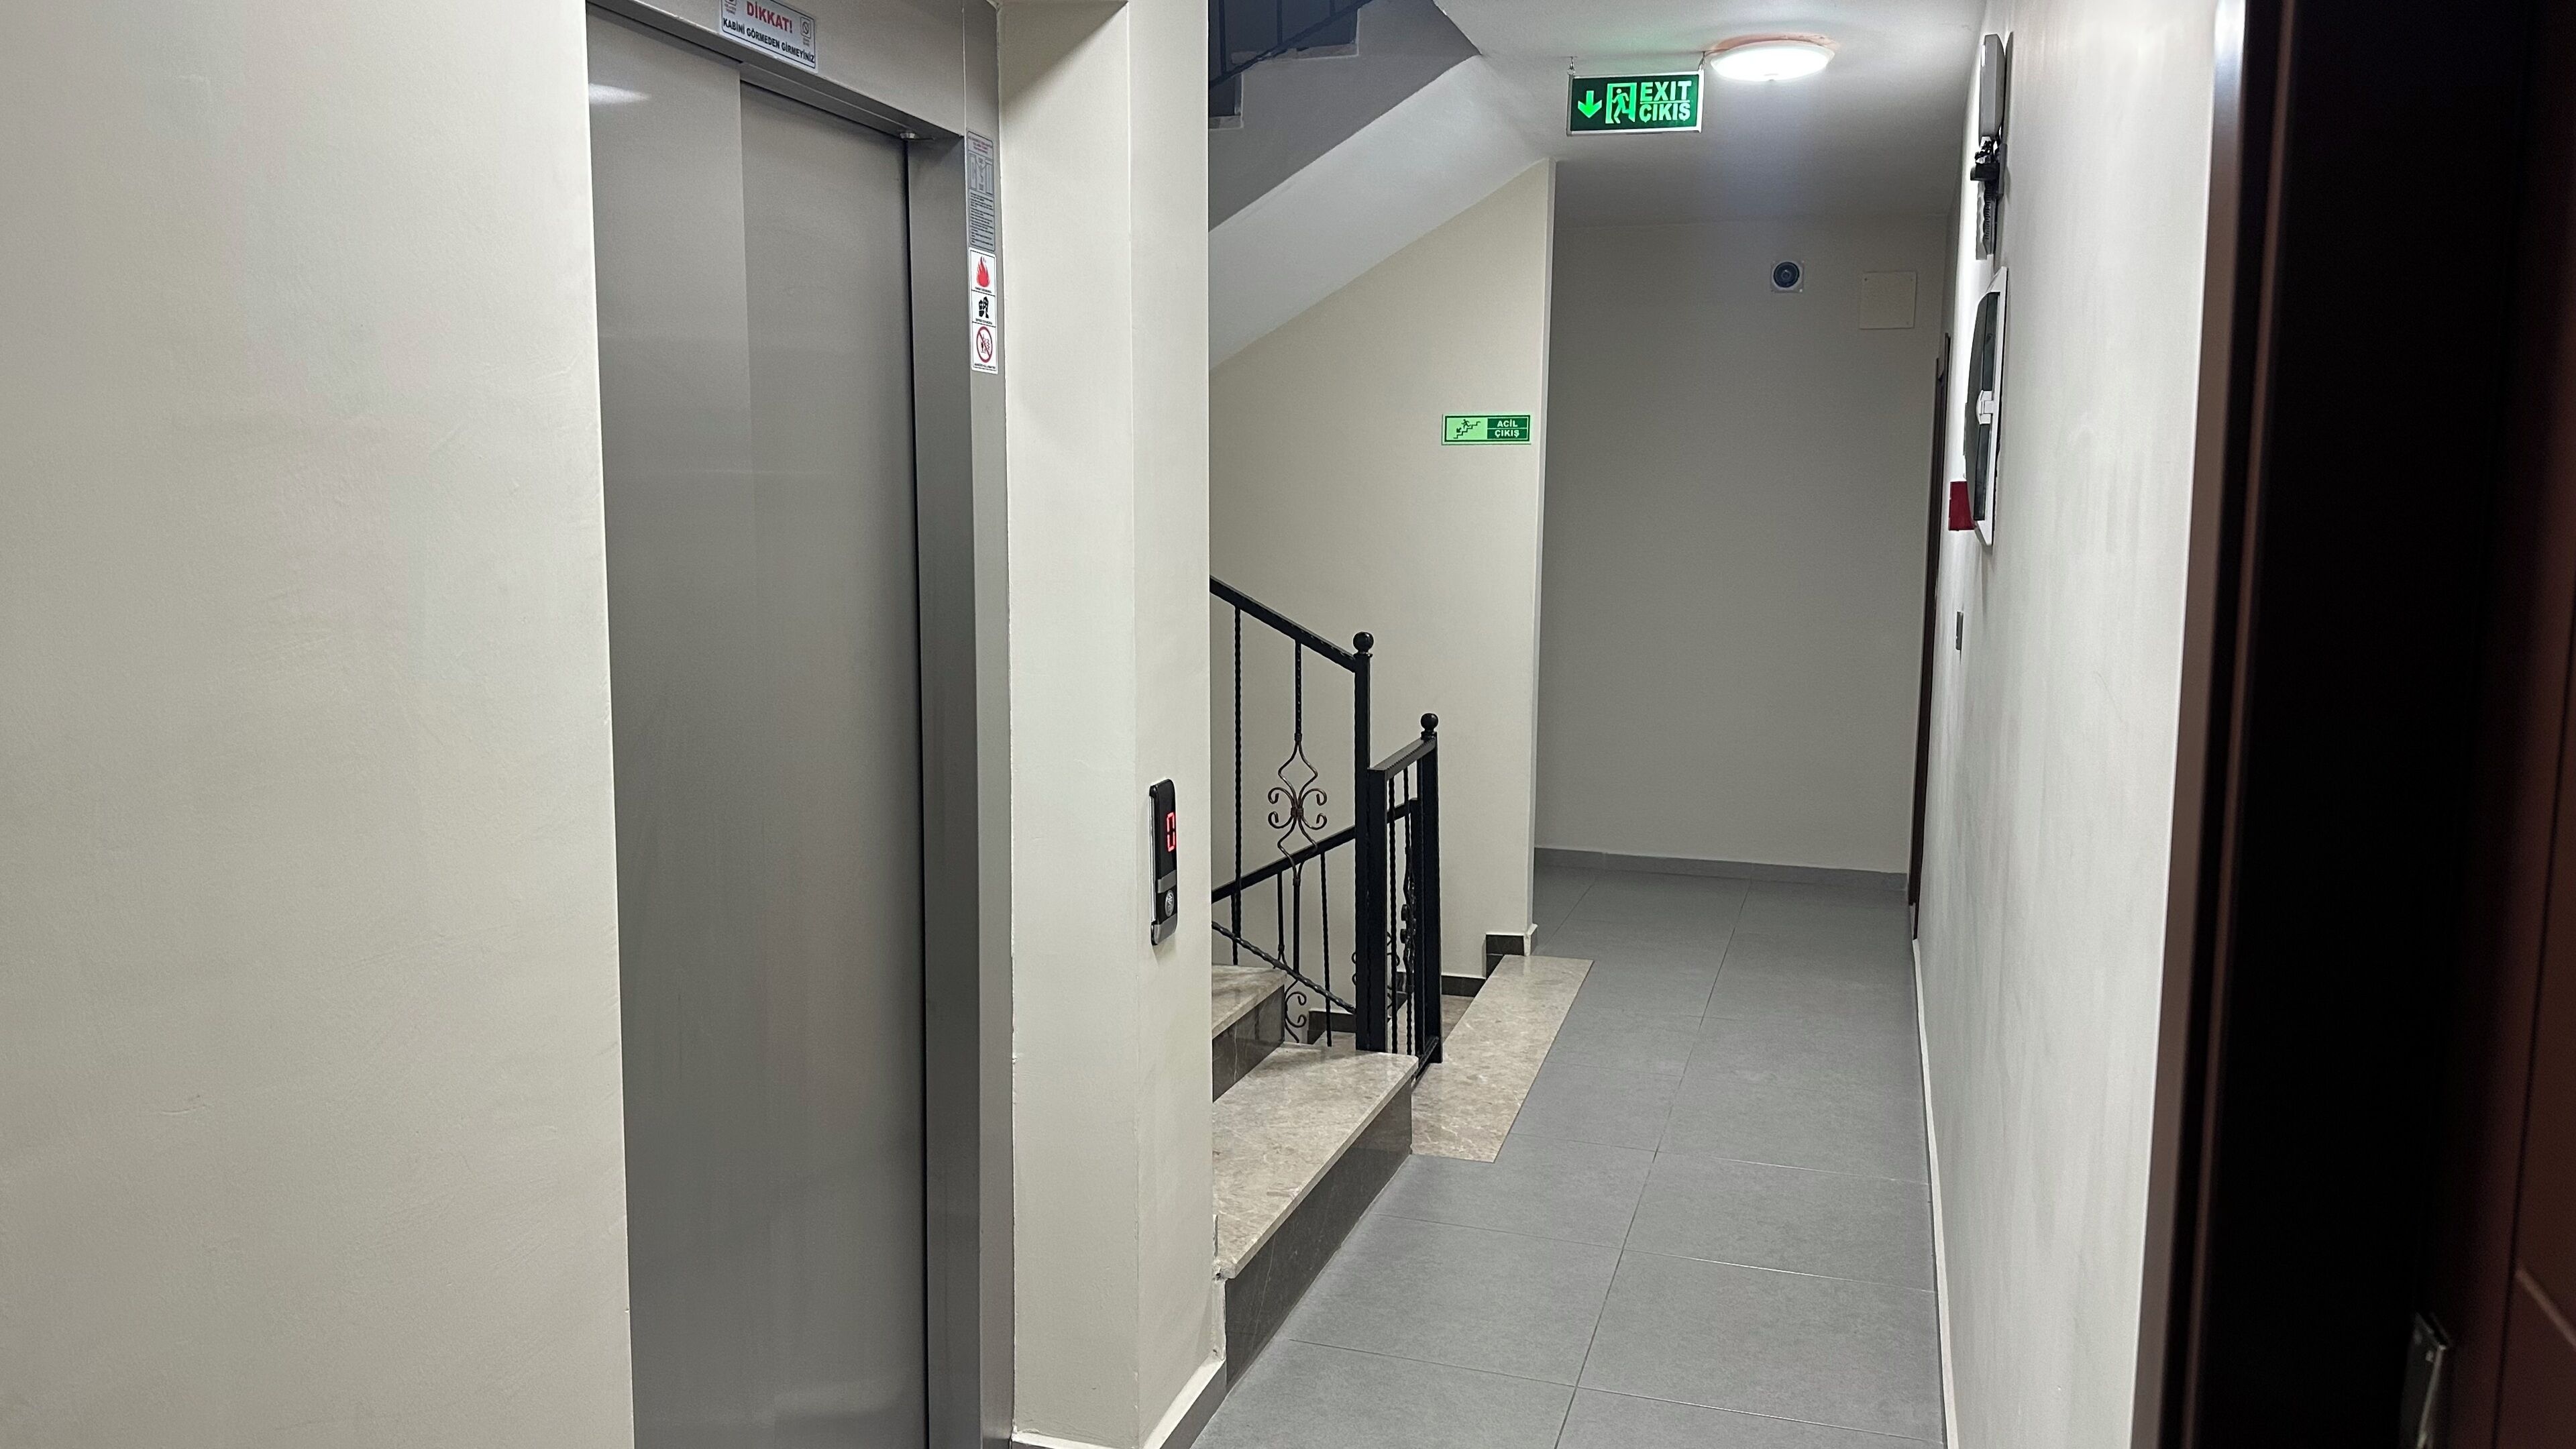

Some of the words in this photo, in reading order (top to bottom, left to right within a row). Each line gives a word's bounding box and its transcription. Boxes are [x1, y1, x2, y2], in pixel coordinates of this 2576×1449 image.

[746, 1, 793, 33] DİKKAT!
[723, 17, 745, 35] KABİNİ
[746, 28, 780, 50] GÖRMEDEN
[782, 42, 815, 63] GİRMEYİNİZ
[1640, 80, 1693, 101] EXIT
[1495, 429, 1520, 438] ÇIKIŞ
[1497, 419, 1518, 427] ACİL
